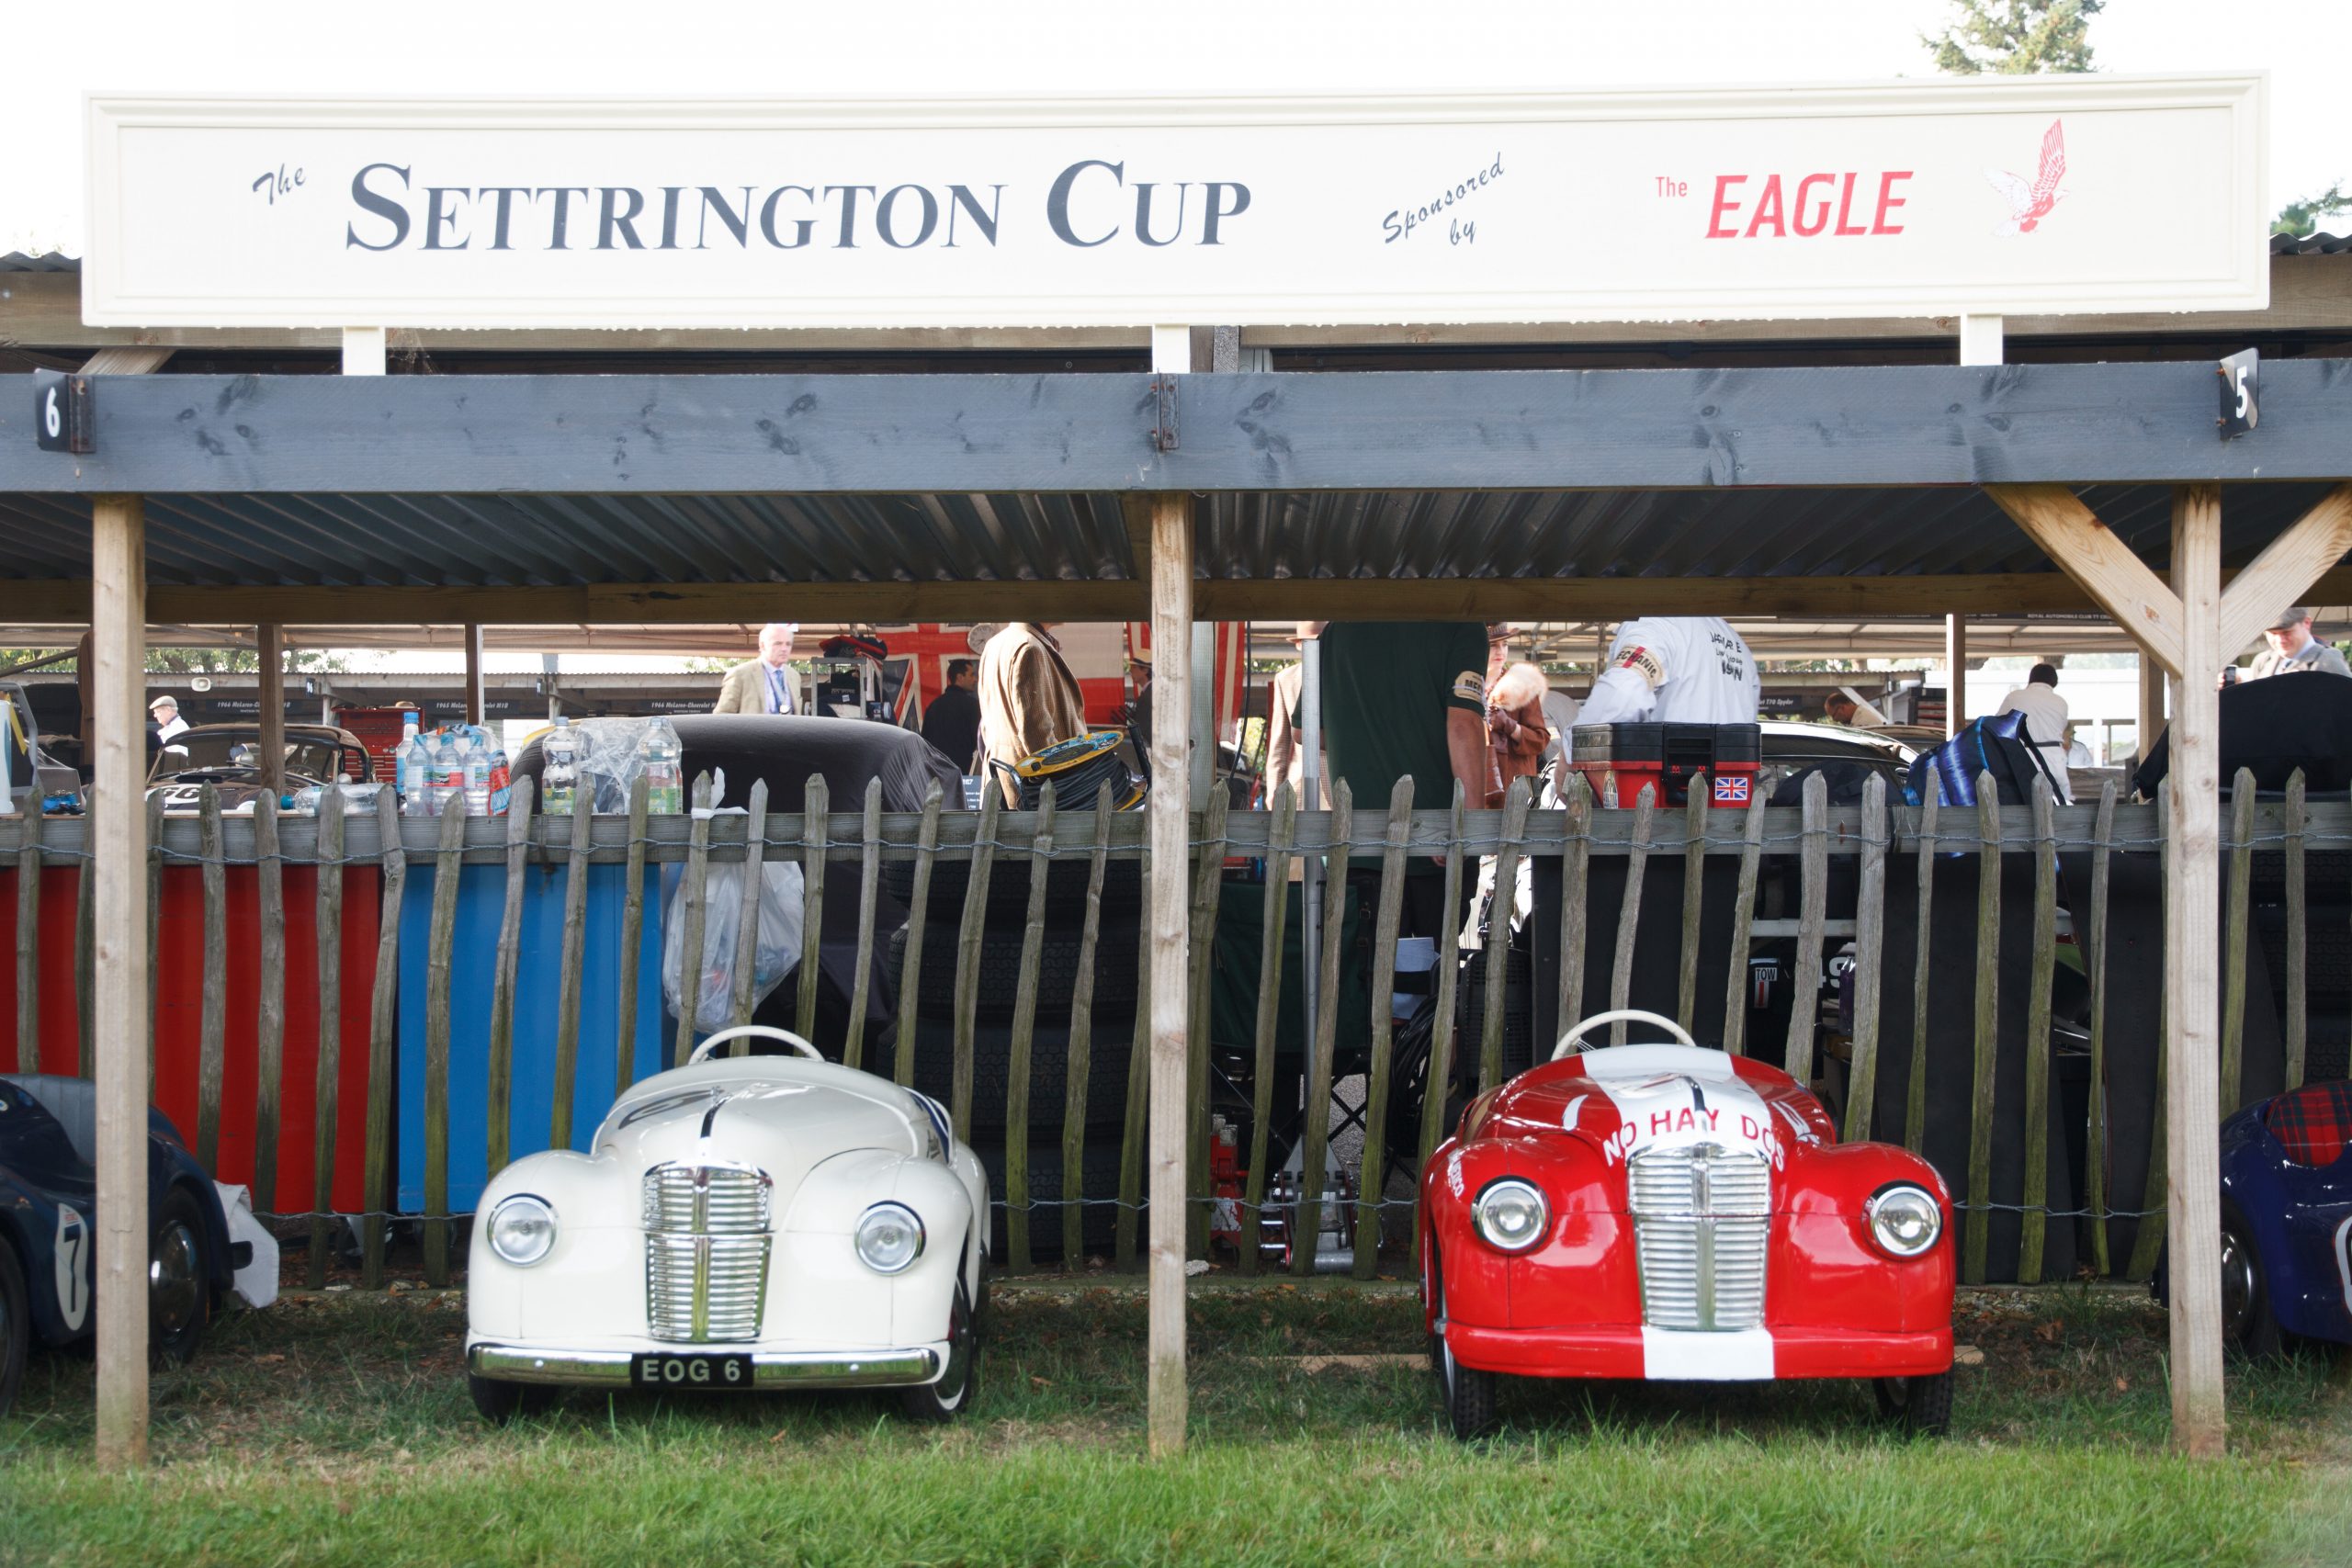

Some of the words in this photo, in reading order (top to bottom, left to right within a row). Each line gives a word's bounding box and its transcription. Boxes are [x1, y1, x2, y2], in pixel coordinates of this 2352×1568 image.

[253, 164, 304, 205] The
[346, 164, 1005, 251] SETTRINGTON
[1047, 160, 1250, 247] CUP
[1382, 151, 1505, 243] Sponsored
[1655, 176, 1688, 197] The
[1704, 171, 1914, 239] EAGLE
[1450, 218, 1476, 246] by
[46, 386, 61, 437] 6
[2235, 365, 2248, 419] 5
[1616, 649, 1657, 679] ECHANIC
[1757, 969, 1776, 981] TOW
[1602, 1121, 1637, 1168] NO
[1651, 1107, 1720, 1137] HAY
[1741, 1114, 1785, 1173] DOS
[63, 1223, 81, 1313] 7
[642, 1359, 710, 1382] EOG
[724, 1359, 741, 1382] 6
